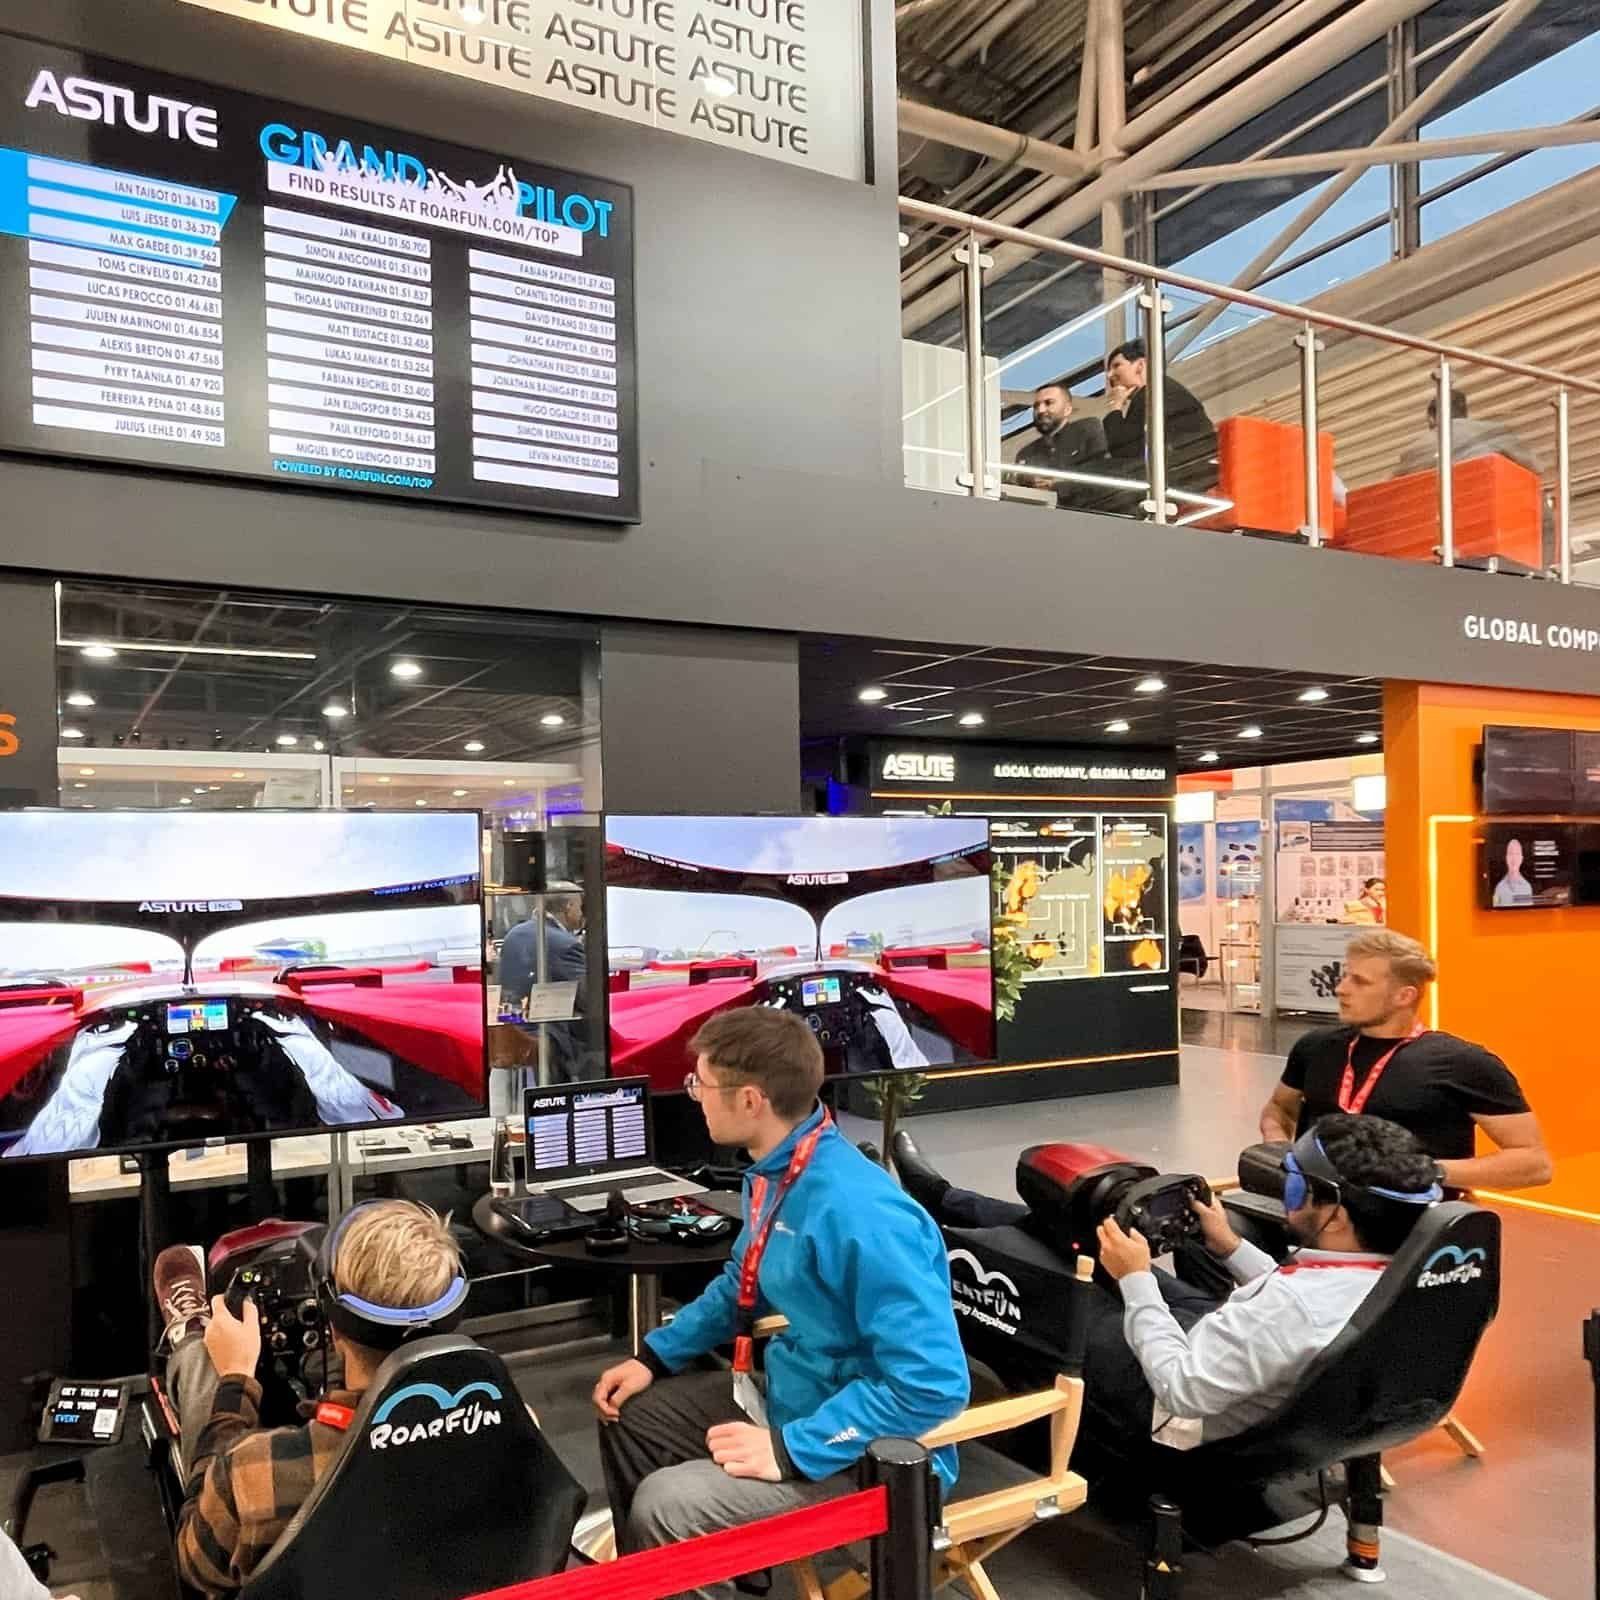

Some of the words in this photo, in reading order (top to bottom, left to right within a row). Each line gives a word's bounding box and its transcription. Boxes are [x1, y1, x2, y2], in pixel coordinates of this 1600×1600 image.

[687, 12, 806, 73] ASTUTE
[544, 12, 676, 76] ASTUTE
[688, 55, 808, 114] ASTUTE
[384, 11, 532, 79] ASTUTE
[544, 58, 676, 118] ASTUTE
[690, 98, 808, 154] ASTUTE
[25, 70, 218, 148] ASTUTE
[259, 123, 427, 190] GRAND
[516, 181, 613, 238] PILOT
[120, 207, 140, 222] LUIS
[143, 211, 169, 228] JESSE
[289, 172, 325, 193] FIND
[330, 178, 397, 209] RESULTS
[399, 198, 416, 214] AT
[420, 202, 560, 245] ROARFUN.COM/TOP
[108, 232, 132, 247] MAX
[135, 236, 169, 254] GAEDE
[338, 225, 356, 240] JAN
[304, 243, 335, 260] SIMON
[97, 256, 125, 272] TOMS
[128, 261, 170, 280] CIRVELIS
[295, 266, 344, 286] MAHMOUD
[86, 281, 120, 298] LUCAS
[122, 287, 172, 306] PEROCCO
[294, 290, 331, 309] THOMAS
[84, 308, 117, 324] JULIEN
[119, 313, 171, 332] MARINONI
[98, 337, 132, 353] ALEXIS
[135, 342, 172, 359] BRETON
[324, 346, 351, 361] LUKAS
[321, 371, 353, 386] FABIAN
[114, 418, 145, 434] JULIUS
[295, 442, 328, 457] MIGUEL
[324, 465, 337, 478] BY
[1464, 614, 1543, 646] GLOBAL
[1547, 624, 1600, 651] COMP
[882, 753, 955, 778] ASTUTE
[993, 765, 1032, 778] LOCAL
[1033, 765, 1088, 780] COMPANY,
[1089, 766, 1130, 780] GLOBAL
[1131, 768, 1166, 780] REACH
[786, 873, 827, 886] ASTUTE
[138, 900, 208, 912] ASTUTE
[54, 1414, 81, 1424] EVENT
